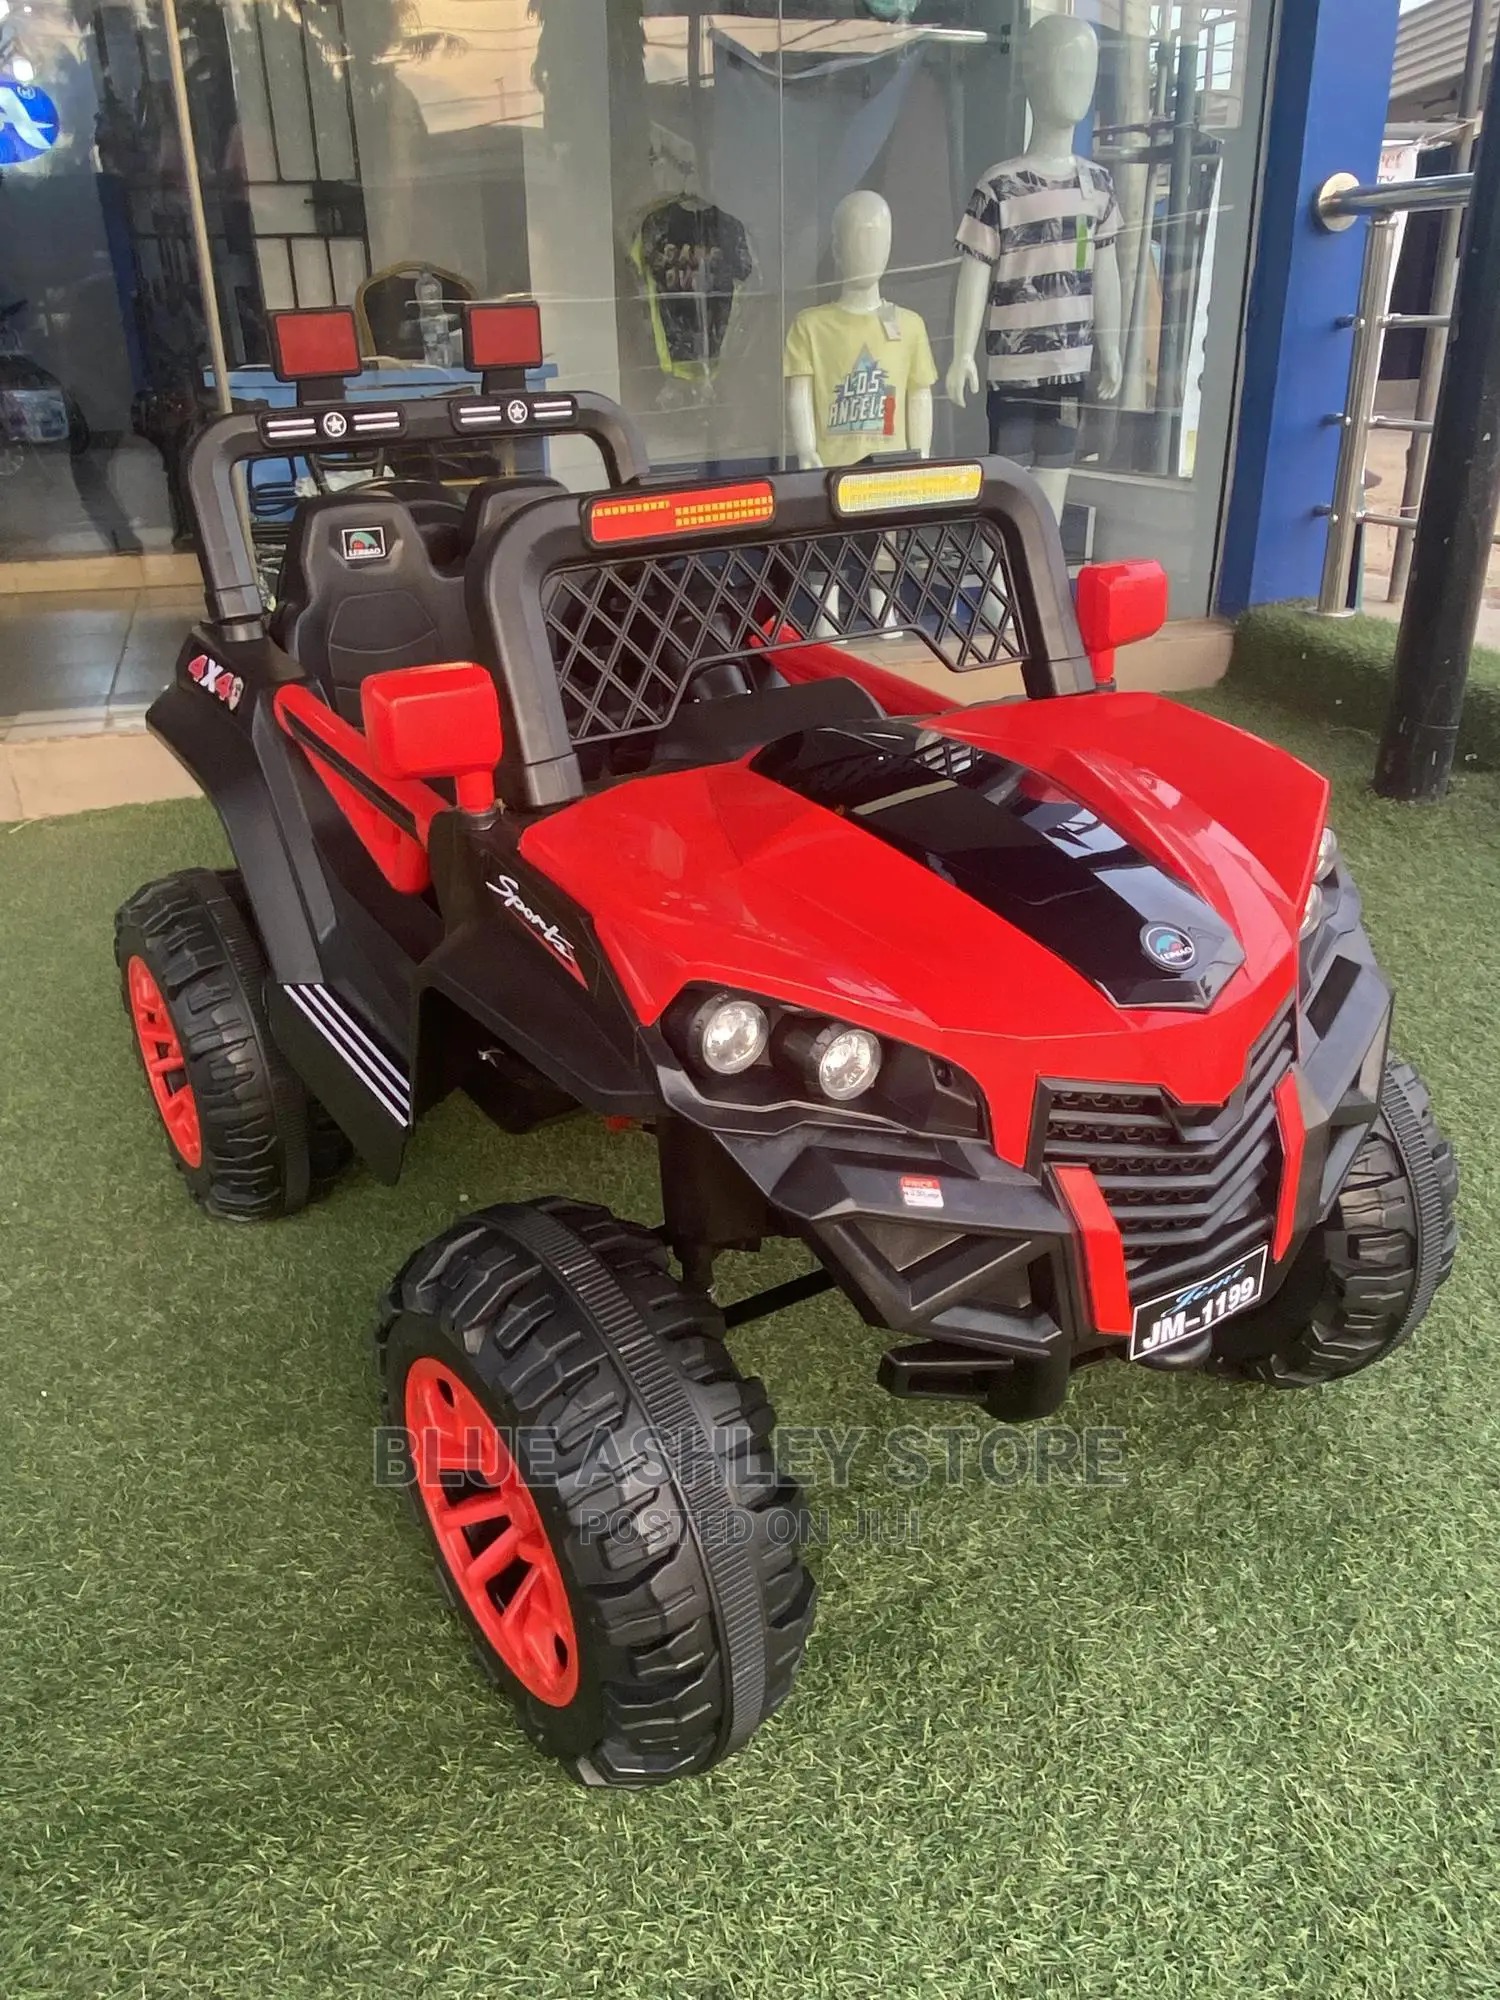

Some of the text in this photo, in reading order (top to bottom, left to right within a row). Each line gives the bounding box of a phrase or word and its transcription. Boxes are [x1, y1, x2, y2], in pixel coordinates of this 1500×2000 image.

[843, 370, 882, 396] LOS
[828, 395, 894, 425] ANGELE
[485, 874, 576, 962] Sports
[1142, 1276, 1255, 1349] JM-1199
